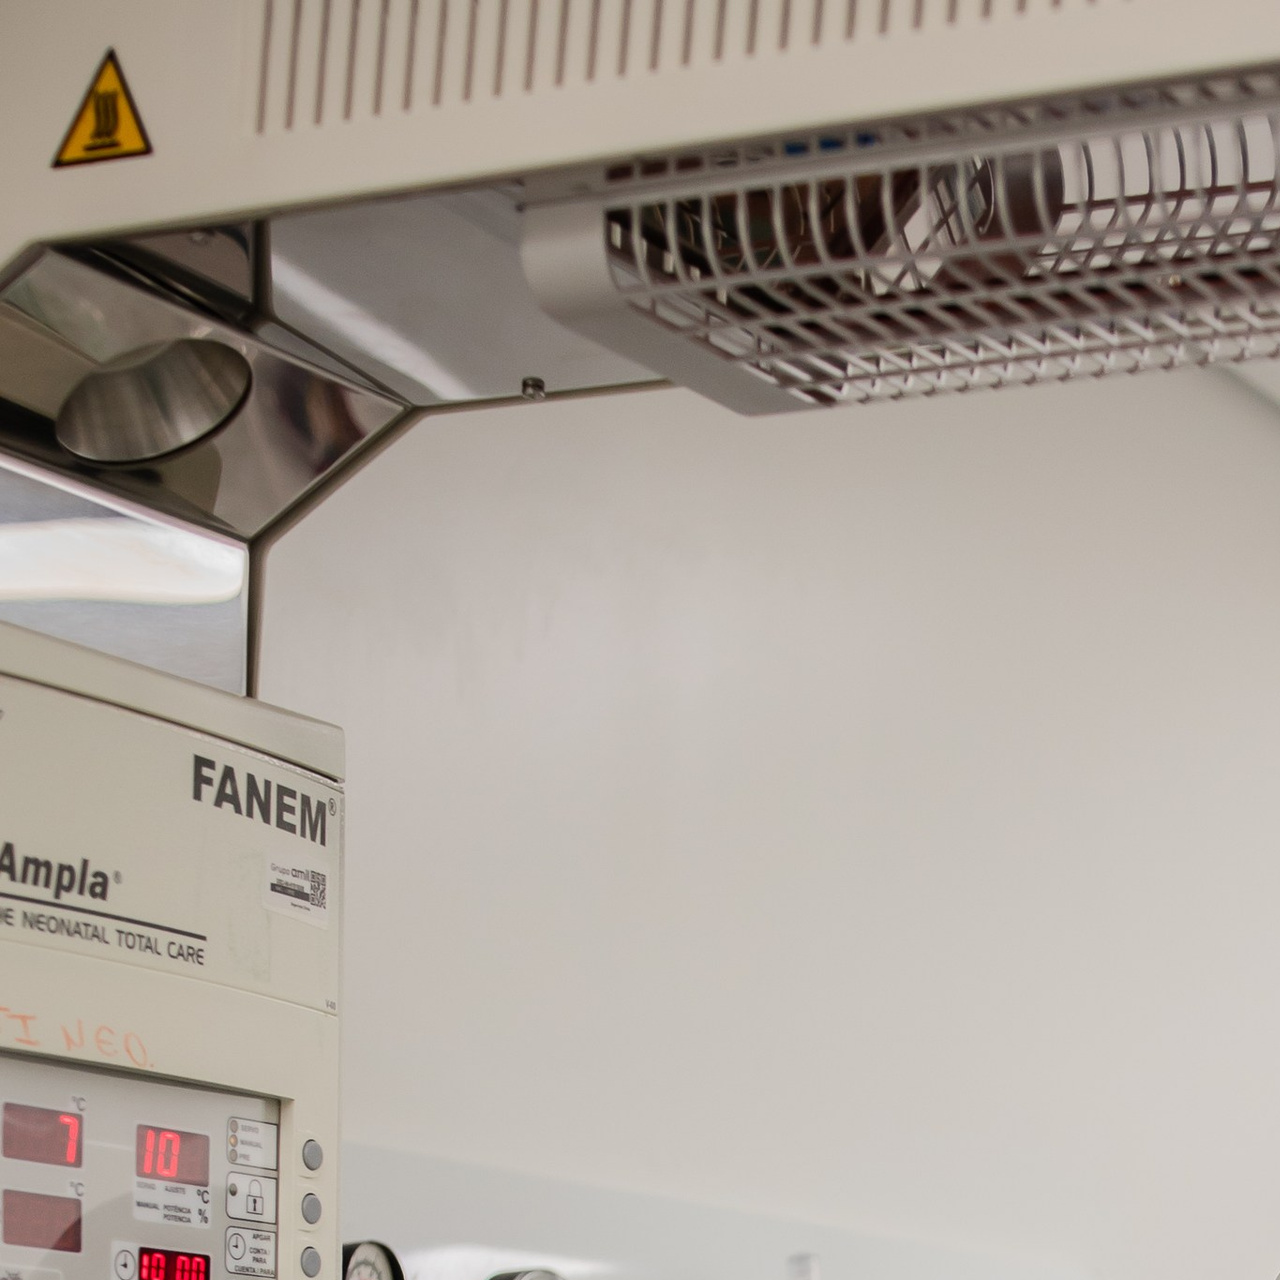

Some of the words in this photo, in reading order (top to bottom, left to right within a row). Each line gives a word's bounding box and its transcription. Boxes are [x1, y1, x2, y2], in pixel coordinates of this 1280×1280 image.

[22, 910, 109, 945] NEONATAL
[115, 929, 162, 957] TOTAL
[167, 941, 205, 966] CARE
[59, 1114, 79, 1164] 7
[143, 1129, 181, 1178] 10
[198, 1208, 209, 1224] %
